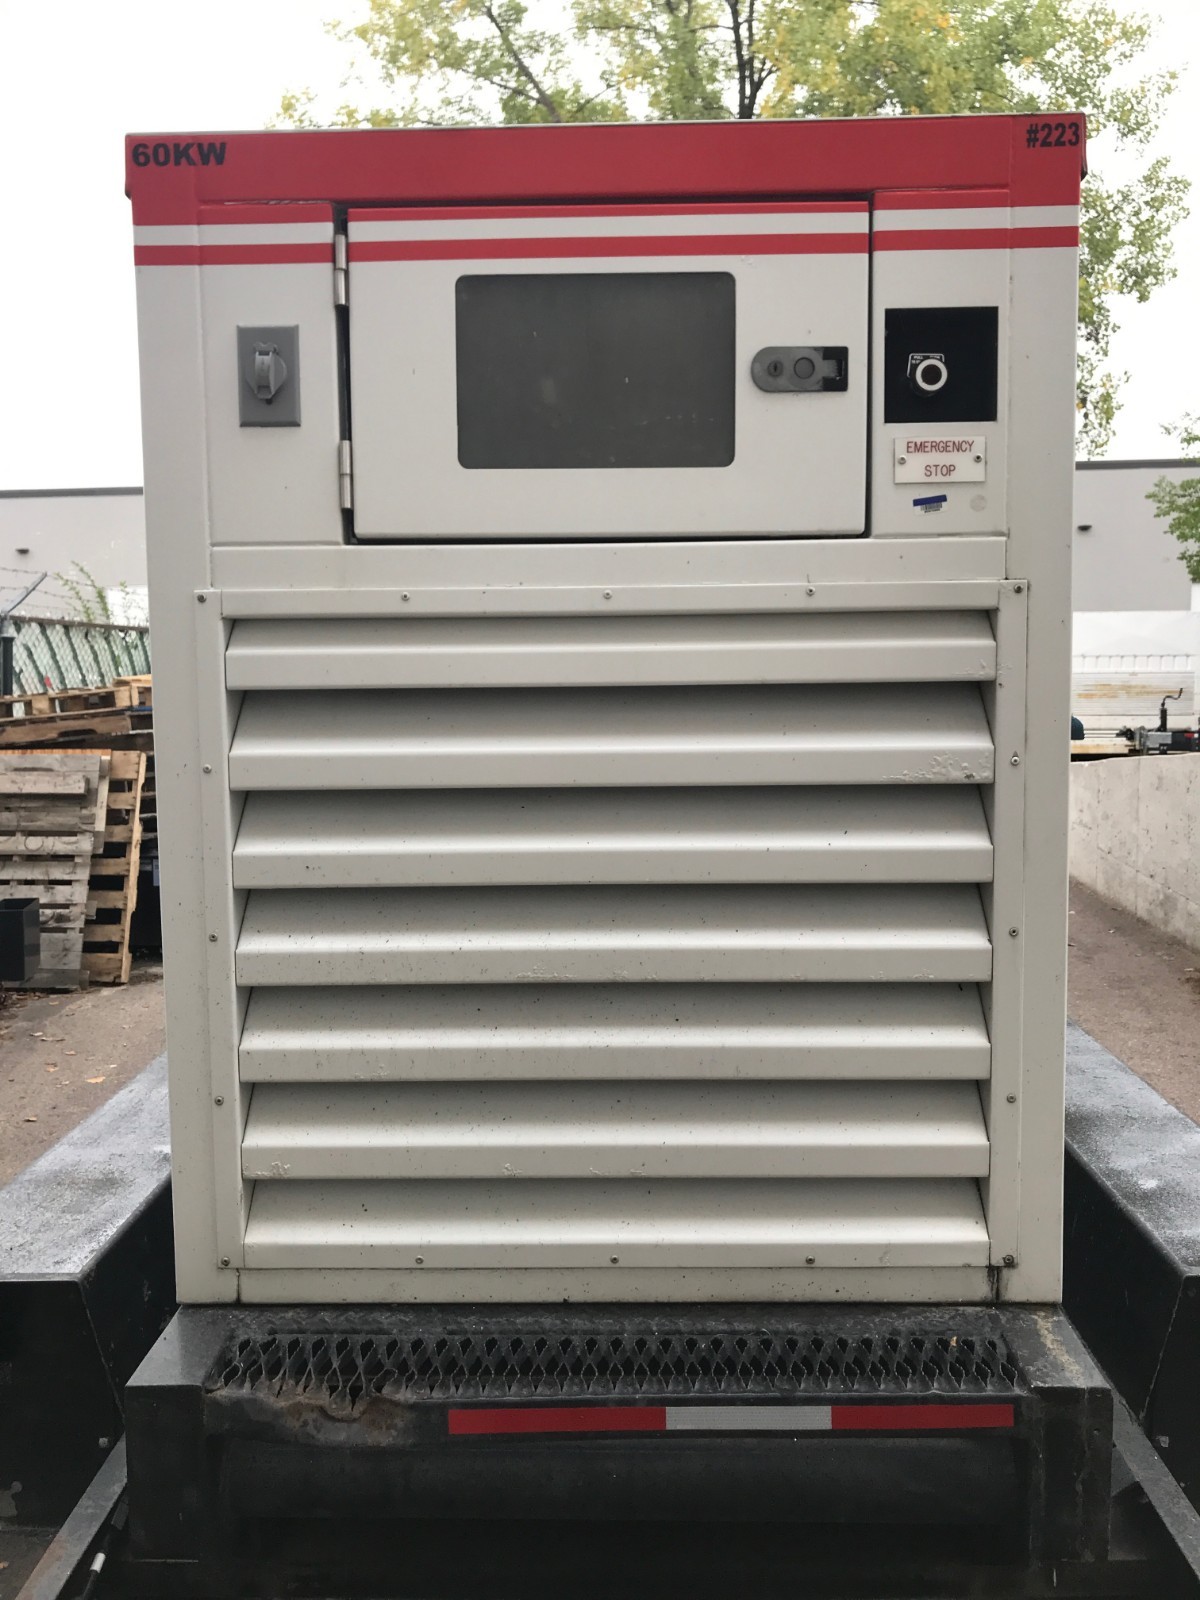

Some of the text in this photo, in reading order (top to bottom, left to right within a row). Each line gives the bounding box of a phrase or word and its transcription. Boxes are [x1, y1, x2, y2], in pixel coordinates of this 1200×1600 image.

[1026, 122, 1080, 148] #223
[131, 142, 227, 167] 60KW
[906, 440, 975, 454] EMERGENCY
[924, 464, 956, 477] STOP
